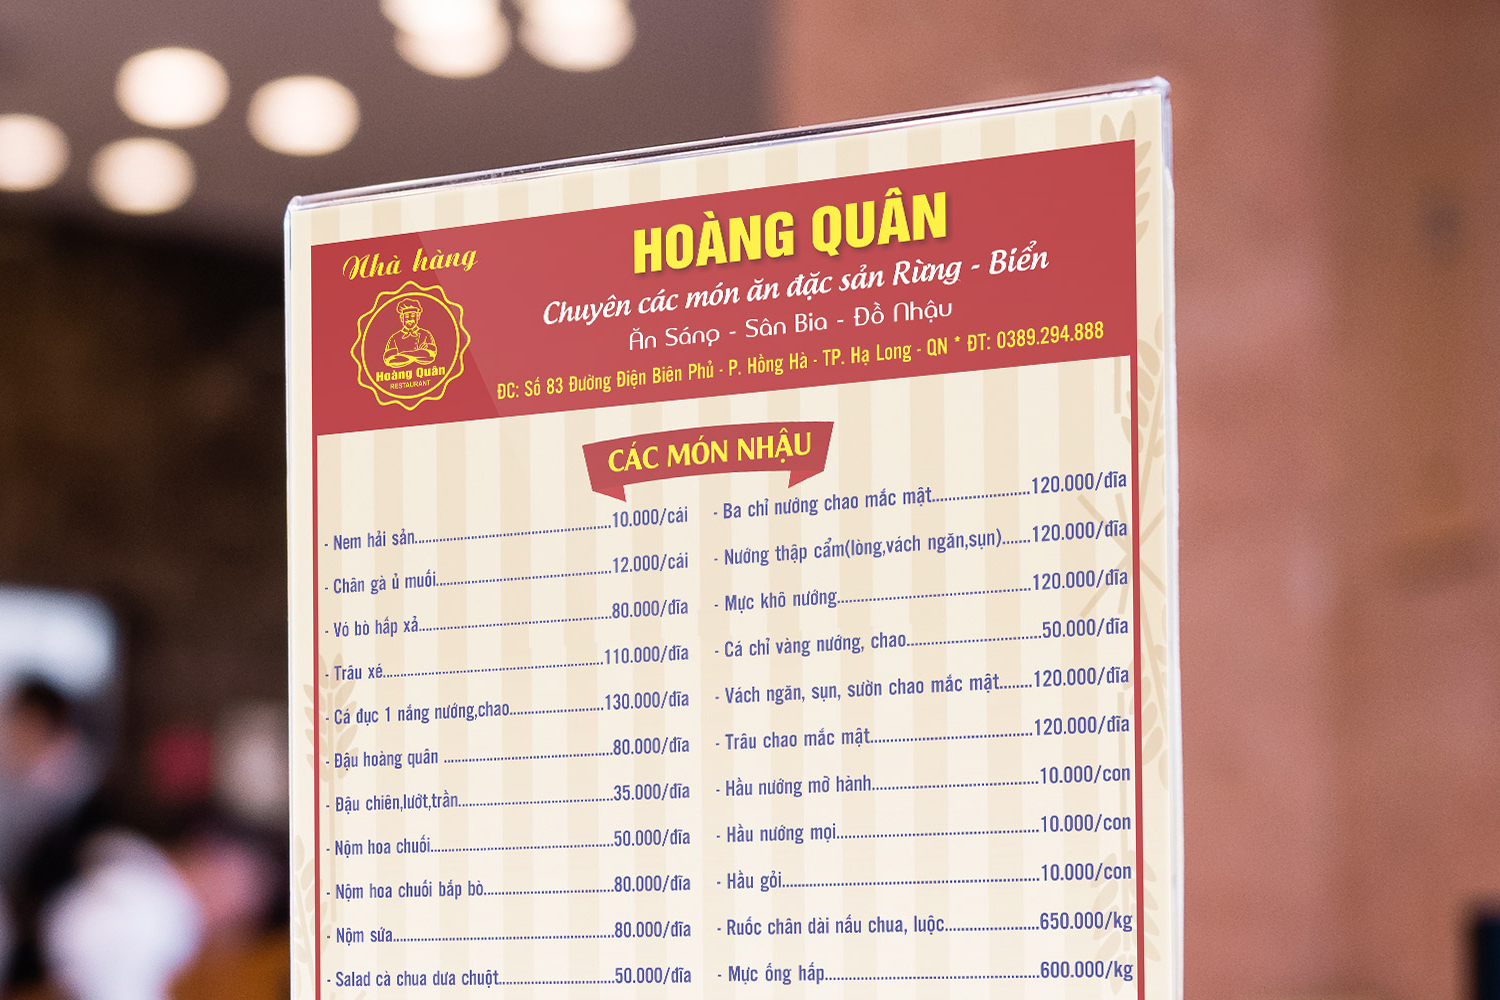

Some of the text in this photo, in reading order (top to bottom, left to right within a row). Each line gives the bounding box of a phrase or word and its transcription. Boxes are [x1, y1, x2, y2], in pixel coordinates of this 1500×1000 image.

[633, 186, 947, 274] HOÀNG QUÂN
[341, 247, 478, 281] Nhà hàng
[542, 239, 1050, 326] Chuyên các món ăn đặc sản Rừng Biển
[628, 298, 953, 351] Ăn Sáng Sân Bia Đồ Nhậu
[376, 365, 446, 382] Hoàng Quân
[496, 320, 1104, 400] ĐC: Số 83 Đường Điện Biên Phủ P. Hồng Hà TP. Hạ Long QN ĐT: 0389.294.888
[389, 379, 432, 390] RESTAURANT
[607, 426, 811, 472] CÁC MÓN NHẬU
[723, 470, 1127, 519] Ba chỉ nướng chao mắc mật 120.000/đĩa
[333, 505, 688, 551] Nem hải sản 10.000/cái
[332, 551, 688, 595] Chân gà ủ muối 12.000/cái
[724, 568, 1128, 614] Mực khô nướng 120.000/đĩa
[333, 598, 688, 638] Vó bò hấp xả 80.000/đĩa
[333, 644, 688, 681] Trâu xé 110.000/đĩa
[724, 714, 1129, 750] Trâu chao mắc mật 120.000/đĩa
[333, 735, 689, 771] Đậu hoàng quân 80.000/đĩa
[726, 813, 1131, 845] Hầu nướng mọi 10.000/con
[335, 874, 691, 902] Nộm hoa chuối bắp bò 80.000/đĩa
[726, 862, 1131, 892] Hầu gỏi 10.000/con
[336, 920, 691, 947] Nộm sứa 80.000/đĩa
[726, 910, 1133, 936] Ruốc chân dài nấu chua, luộc 650.000/kg
[335, 966, 691, 989] Salad cà chua dưa chuột 50.000/đĩa
[728, 959, 1134, 986] Mực ống hấp 600.000/kg
